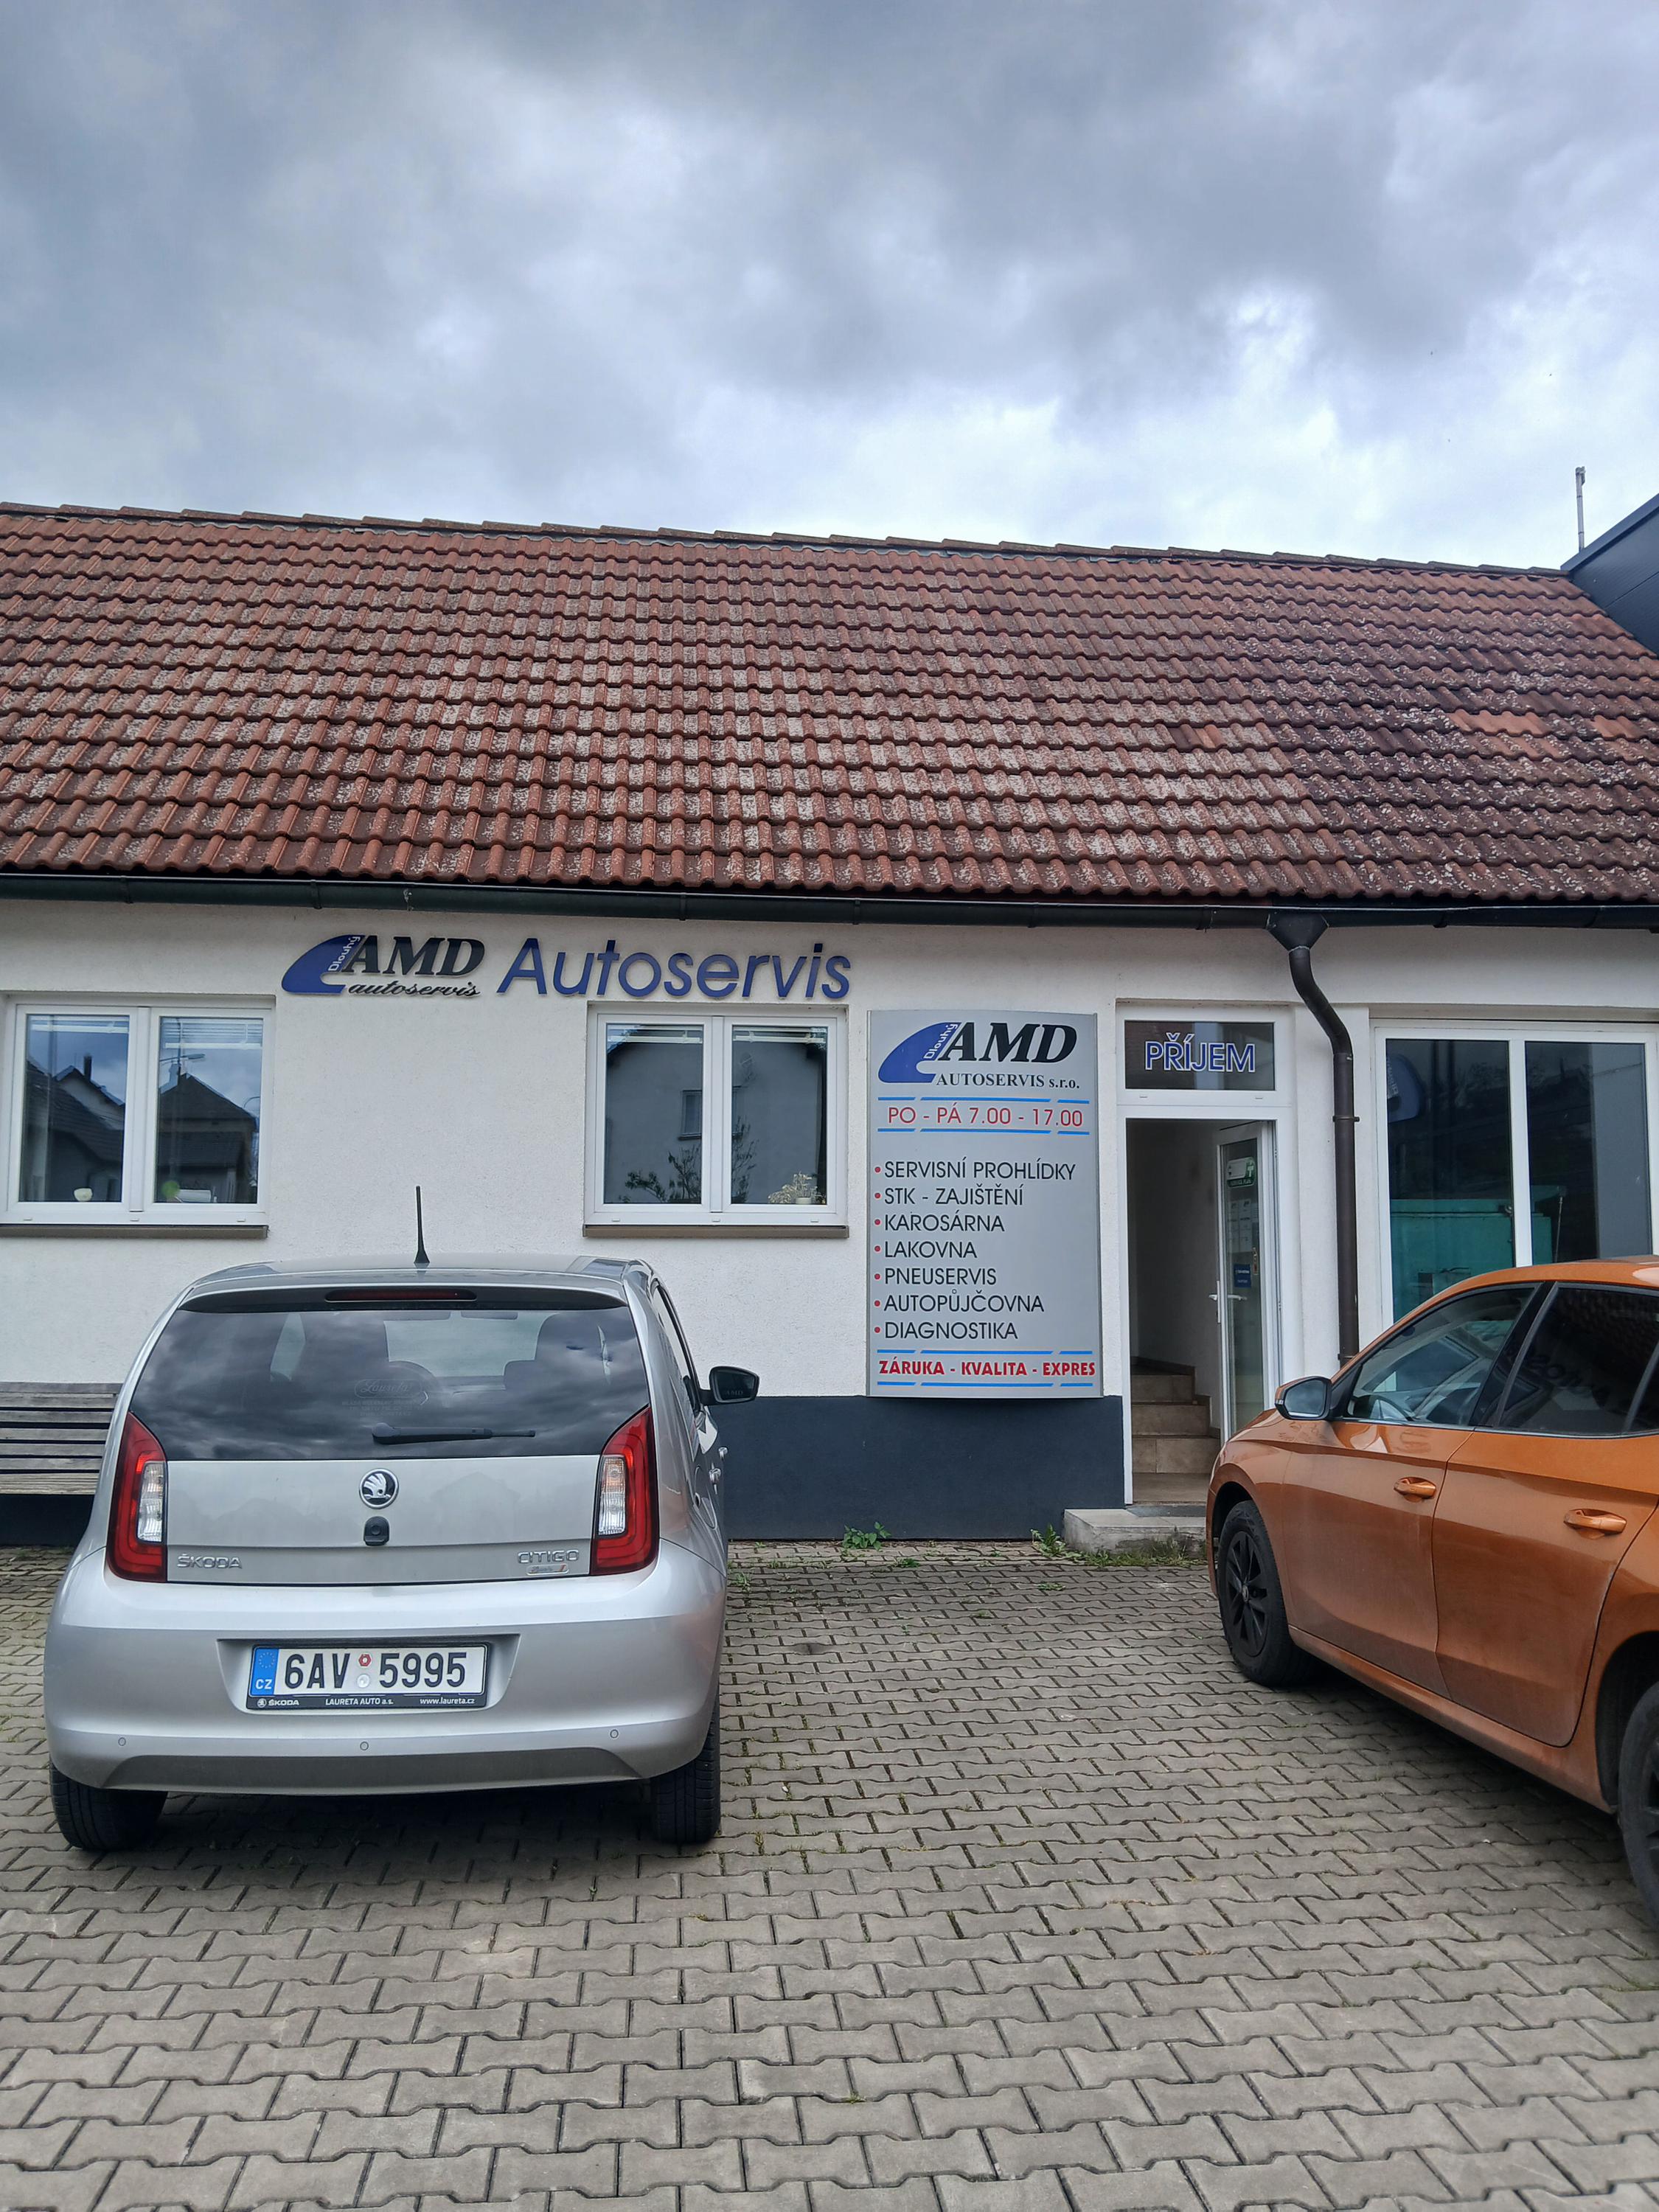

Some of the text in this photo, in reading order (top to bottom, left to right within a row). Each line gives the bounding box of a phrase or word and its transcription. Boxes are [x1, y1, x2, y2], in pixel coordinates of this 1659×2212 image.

[327, 935, 361, 973] Dlouhý
[341, 934, 851, 999] AMD Autoservis
[347, 979, 481, 997] autoservis
[924, 1023, 959, 1060] Dlouhý
[937, 1022, 1077, 1063] AMD
[1145, 1032, 1255, 1073] PŘÍJEM
[936, 1073, 1080, 1089] AUTOSERVIS s.r.o.
[888, 1107, 916, 1124] PO
[936, 1102, 961, 1124] PÁ
[969, 1107, 1011, 1125] 7.00
[1032, 1108, 1083, 1127] 17.00
[884, 1157, 1076, 1180] SERVISNÍ PROHLÍDKY
[884, 1188, 916, 1205] STK
[935, 1183, 1023, 1206] ZAJIŠTĚNÍ
[885, 1210, 1005, 1231] KAROSÁRNA
[885, 1241, 978, 1259] LAKOVNA
[885, 1267, 997, 1285] PNEUSERVIS
[883, 1289, 1045, 1312] AUTOPŮJČOVNA
[885, 1321, 1018, 1340] DIAGNOSTIKA
[879, 1357, 945, 1375] ZÁRUKA
[961, 1362, 1028, 1376] KVALITA
[1043, 1362, 1096, 1377] EXPRES
[176, 1553, 242, 1569] ŠKODA
[518, 1549, 580, 1564] CITIGO
[284, 1652, 467, 1689] 6AV 5995
[255, 1679, 272, 1690] CZ
[268, 1698, 299, 1706] ŠKODA
[325, 1698, 359, 1706] LAURETA
[360, 1697, 380, 1705] AUTO
